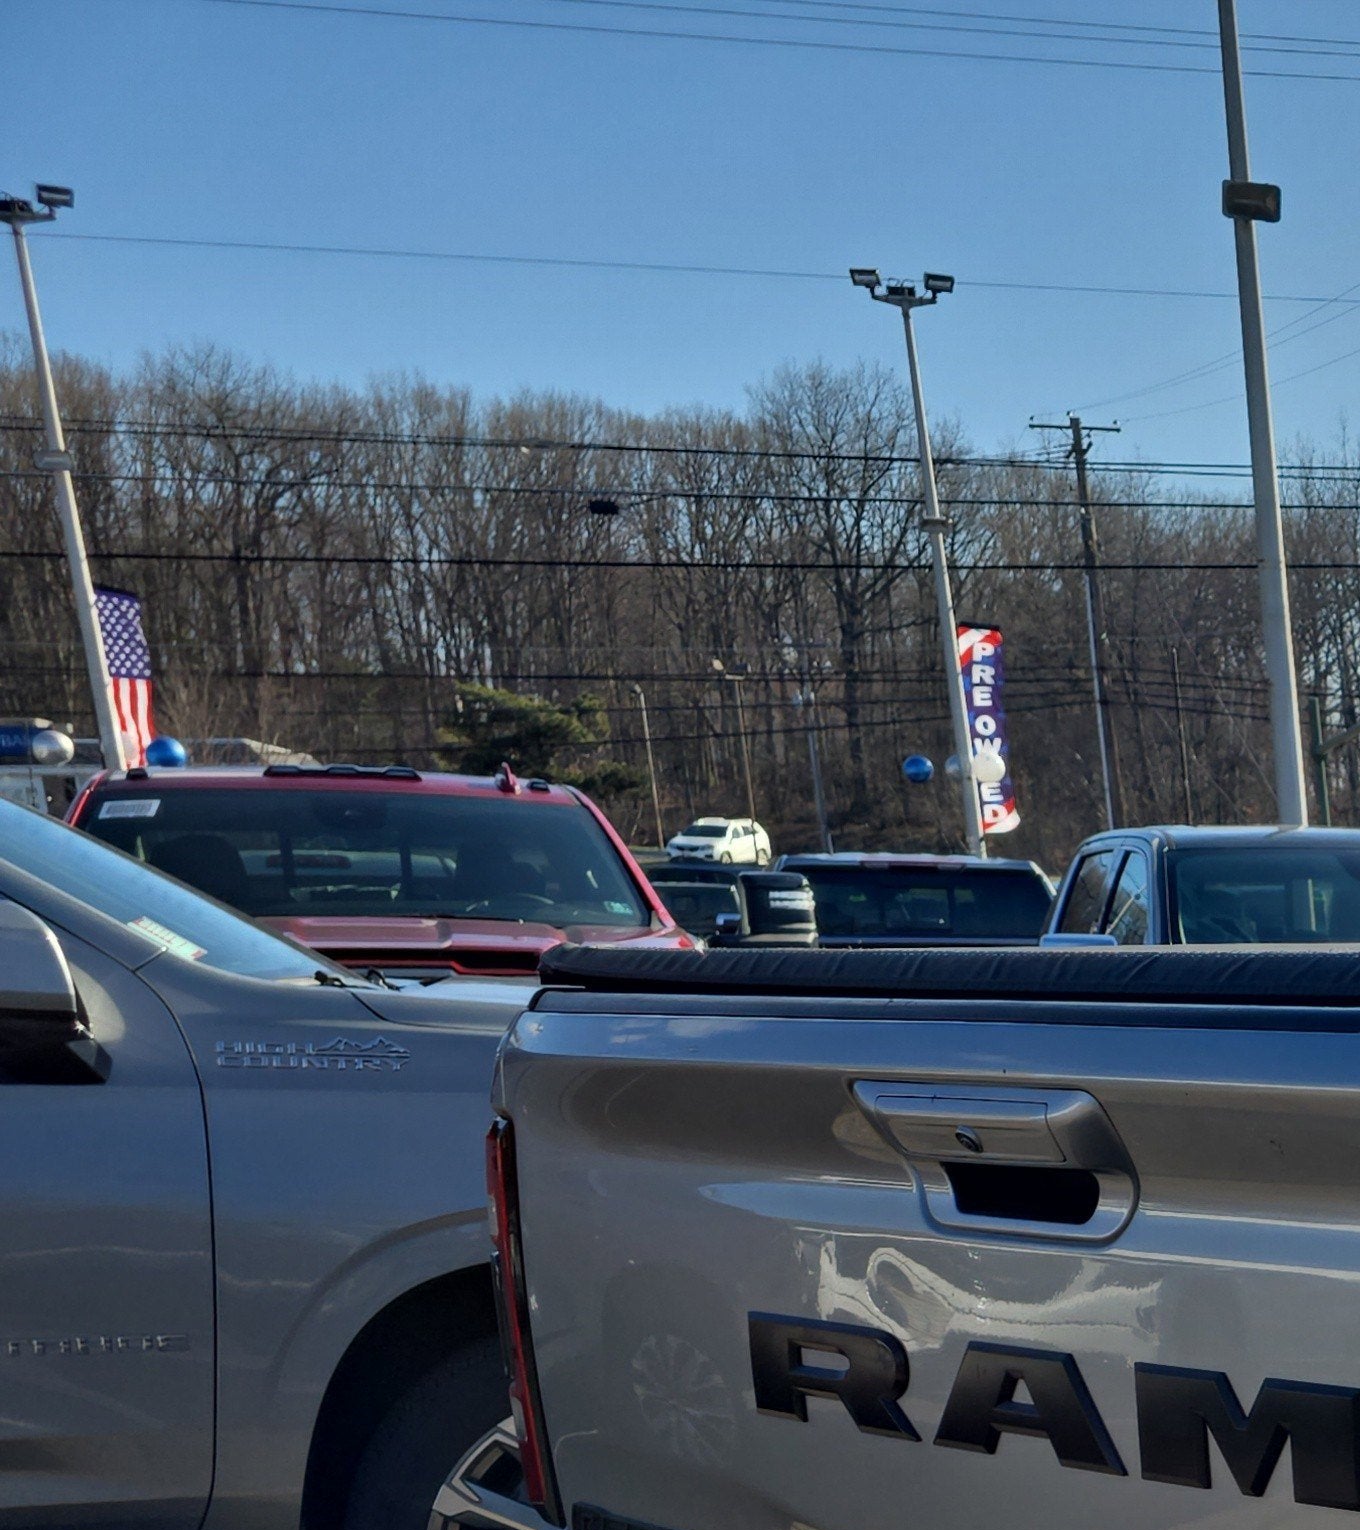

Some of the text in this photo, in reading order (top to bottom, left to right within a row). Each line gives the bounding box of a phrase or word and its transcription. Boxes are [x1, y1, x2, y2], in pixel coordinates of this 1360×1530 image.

[971, 642, 1009, 824] PRE OWED
[215, 1040, 315, 1054] HIGH
[216, 1056, 410, 1072] COUNTRY
